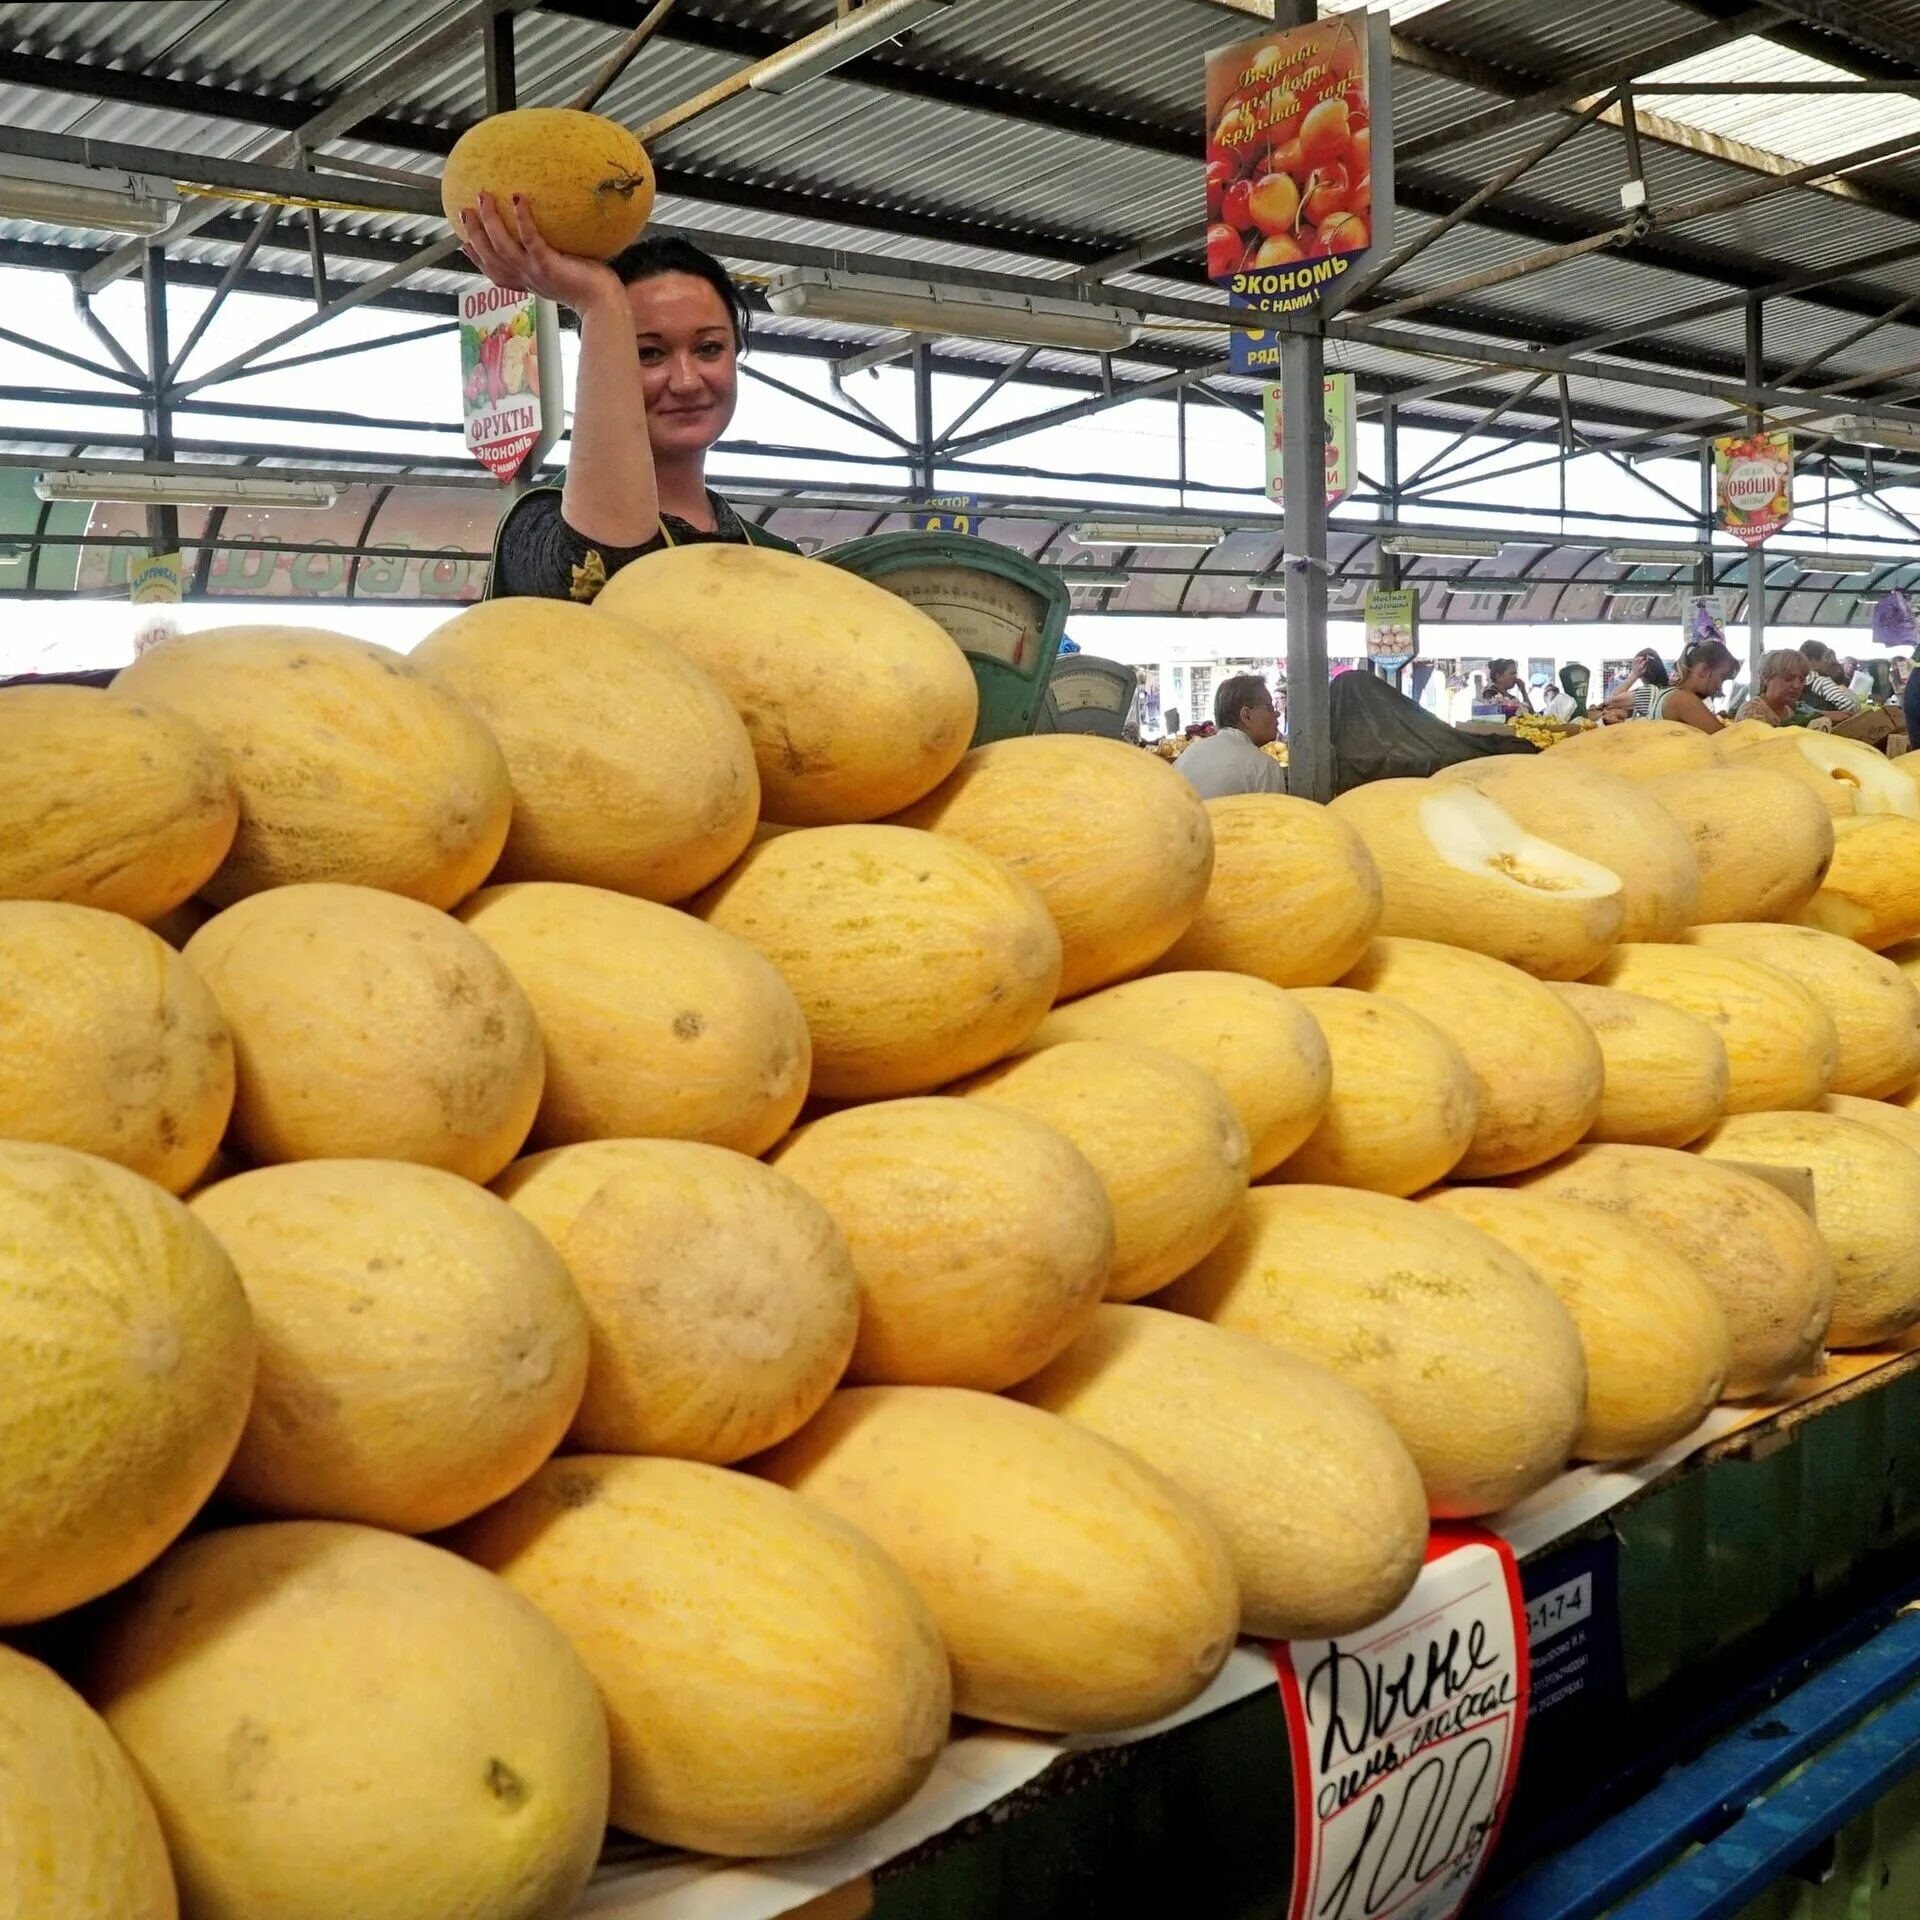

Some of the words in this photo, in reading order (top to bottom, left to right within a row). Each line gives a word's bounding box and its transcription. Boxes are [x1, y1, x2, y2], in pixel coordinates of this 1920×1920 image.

[1231, 256, 1349, 294] ЭКОНОМЬ
[1260, 298, 1270, 311] С
[471, 405, 535, 441] ФРУКТЫ
[477, 435, 532, 461] ЭКОНОМЬ
[1726, 521, 1778, 536] ЭКОНОМЬ
